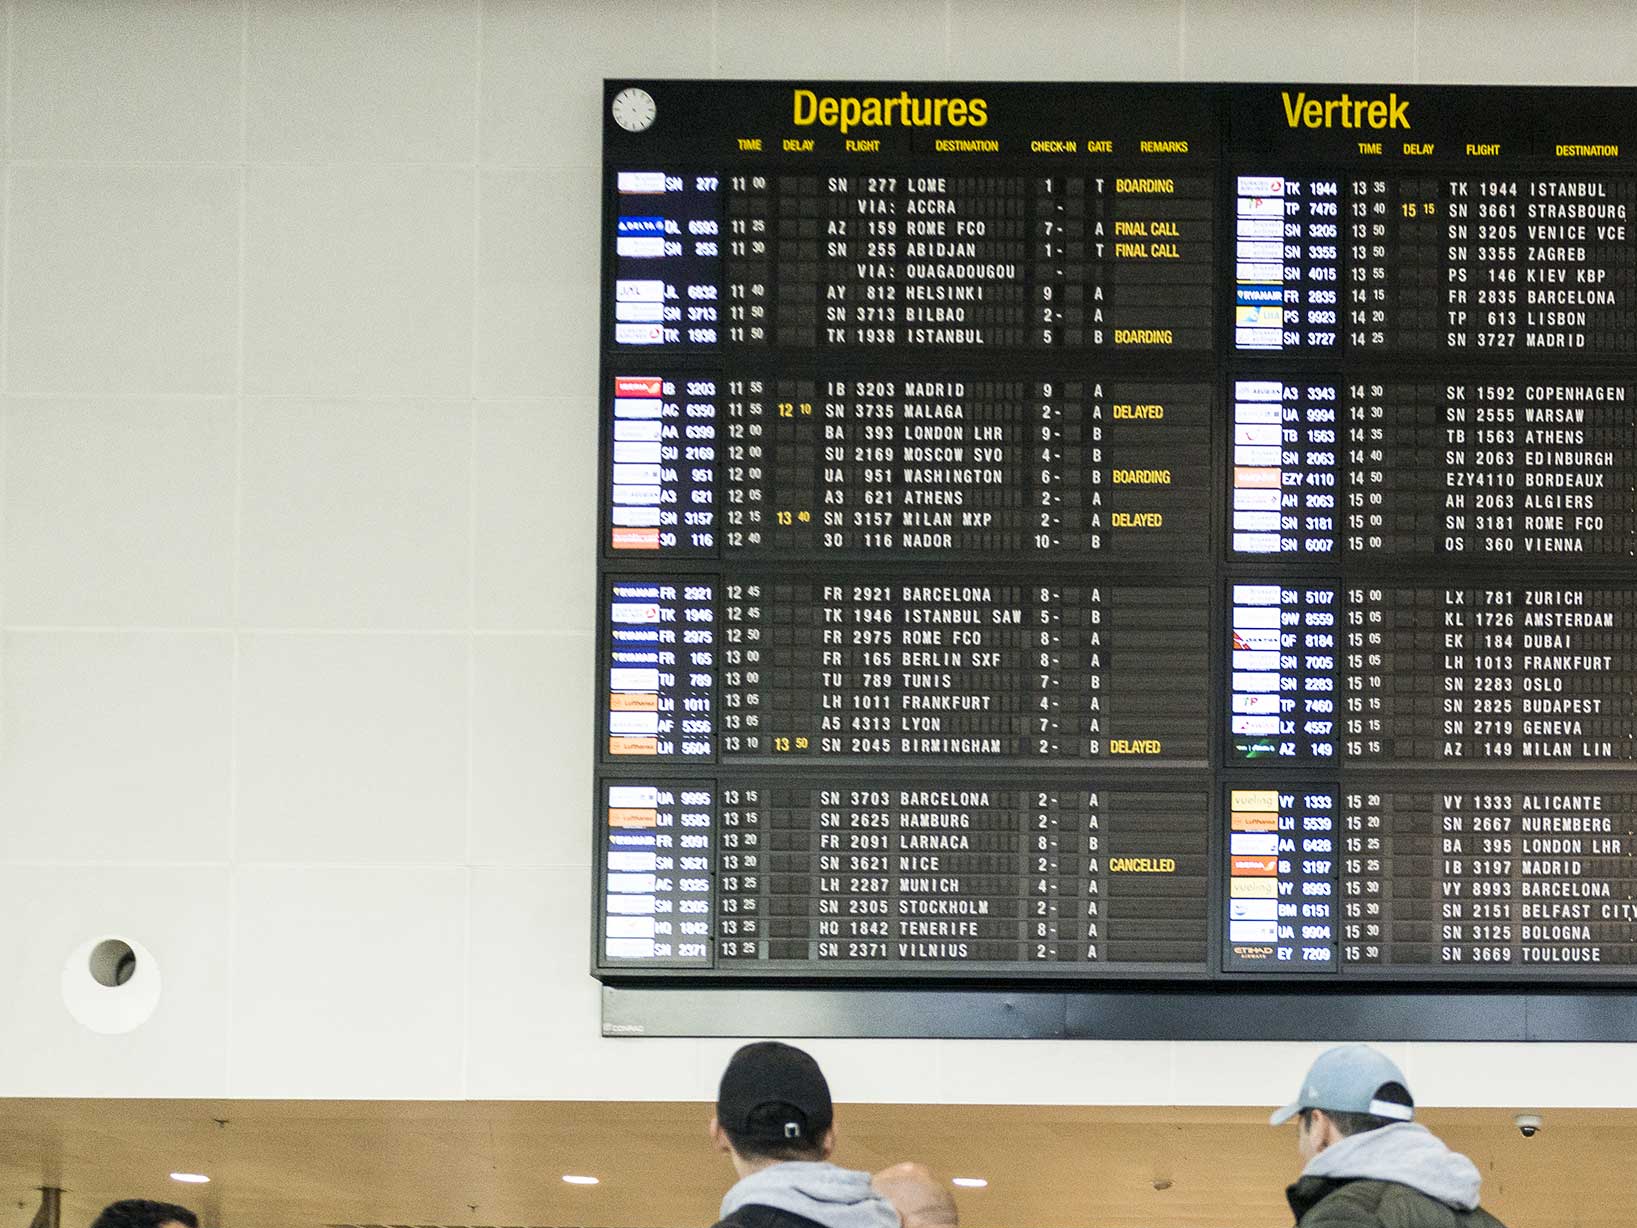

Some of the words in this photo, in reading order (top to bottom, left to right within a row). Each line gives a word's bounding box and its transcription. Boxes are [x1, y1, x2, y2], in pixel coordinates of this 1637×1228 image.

[793, 90, 988, 133] Departures
[1281, 92, 1411, 129] Vertrek
[737, 138, 762, 151] TIME
[783, 139, 815, 151] DELAY
[845, 139, 881, 152] FLIGHT
[935, 139, 999, 152] DESTINATION
[1030, 140, 1077, 153] CHECK-IN
[1087, 140, 1113, 153] GATE
[1140, 141, 1189, 153] REMARKS
[1358, 143, 1382, 155] TIME
[1403, 143, 1435, 155] DELAY
[1466, 144, 1501, 156] FLIGHT
[1555, 145, 1619, 157] DESTINATION
[908, 178, 946, 193] LOME
[1116, 178, 1174, 193] BOARDING
[1530, 182, 1606, 197] ISTANBUL
[907, 199, 956, 215] ACCRA
[1528, 204, 1626, 219] STRASBOURG
[907, 220, 946, 236] ROME
[957, 221, 986, 236] FCO
[1115, 221, 1147, 236] FINAL
[1149, 222, 1180, 236] CALL
[1527, 225, 1586, 240] VENICE
[1597, 226, 1625, 241] VCE
[906, 242, 976, 257] ABIDJAN
[1115, 243, 1147, 258] FINAL
[1149, 243, 1180, 258] CALL
[1528, 247, 1586, 262] ZAGREB
[906, 264, 1015, 279] OUAGADOUGOU
[1527, 268, 1566, 283] KIEV
[1577, 269, 1606, 283] KBP
[906, 285, 983, 301] HELSINKI
[1527, 290, 1616, 305] BARCELONA
[906, 307, 965, 322] BILBAO
[1528, 311, 1586, 326] LISBON
[908, 328, 984, 344] ISTANBUL
[1114, 329, 1173, 344] BOARDING
[905, 382, 964, 397] MADRID
[1525, 386, 1625, 401] COPENHAGEN
[904, 404, 964, 419] MALAGA
[1113, 405, 1164, 419] DELAYED
[1525, 408, 1584, 423] WARSAW
[904, 425, 963, 441] LONDON
[974, 426, 1003, 441] LHR
[903, 447, 964, 462] MOSCOW
[973, 447, 1003, 462] SVO
[1525, 451, 1613, 466] EDINBURGH
[903, 468, 1002, 484] WASHINGTON
[1112, 469, 1171, 484] BOARDING
[1525, 473, 1604, 488] BORDEAUX
[904, 490, 963, 505] ATHENS
[1524, 494, 1593, 509] ALGIERS
[902, 512, 952, 527] MILAN
[962, 512, 992, 527] MXP
[1111, 513, 1163, 527] DELAYED
[1525, 516, 1564, 530] ROME
[1575, 516, 1603, 531] FCO
[903, 533, 952, 548] NADOR
[1524, 537, 1583, 552] VIENNA
[903, 587, 992, 602] BARCELONA
[1525, 591, 1583, 605] ZURICH
[905, 609, 981, 624] ISTANBUL
[992, 609, 1022, 624] SAW
[1524, 612, 1613, 627] AMSTERDAM
[1524, 634, 1570, 649] DUBAI
[902, 652, 961, 667] BERLIN
[971, 652, 1001, 667] SXF
[902, 673, 951, 688] TUNIS
[1523, 677, 1562, 692] OSLO
[902, 695, 991, 710] FRANKFURT
[1523, 699, 1601, 714] BUDAPEST
[902, 717, 941, 731] LYON
[901, 738, 1001, 753] BIRMINGHAM
[1110, 739, 1161, 754] DELAYED
[1522, 742, 1572, 757] MILAN
[1583, 742, 1611, 757] LIN
[1522, 795, 1602, 810] ALICANTE
[900, 813, 969, 828] HAMBURG
[1522, 817, 1611, 832] NUREMBERG
[900, 835, 969, 850] LARNACA
[1523, 839, 1581, 854] LONDON
[1592, 839, 1621, 854] LHR
[899, 856, 939, 871] NICE
[1109, 858, 1176, 872] CANCELLED
[899, 878, 959, 893] MUNICH
[899, 899, 989, 915] STOCKHOLM
[1522, 903, 1591, 918] BELFAST
[899, 921, 978, 936] TENERIFE
[1522, 925, 1591, 940] BOLOGNA
[898, 943, 968, 958] VILNIUS
[1522, 947, 1600, 962] TOULOUSE
